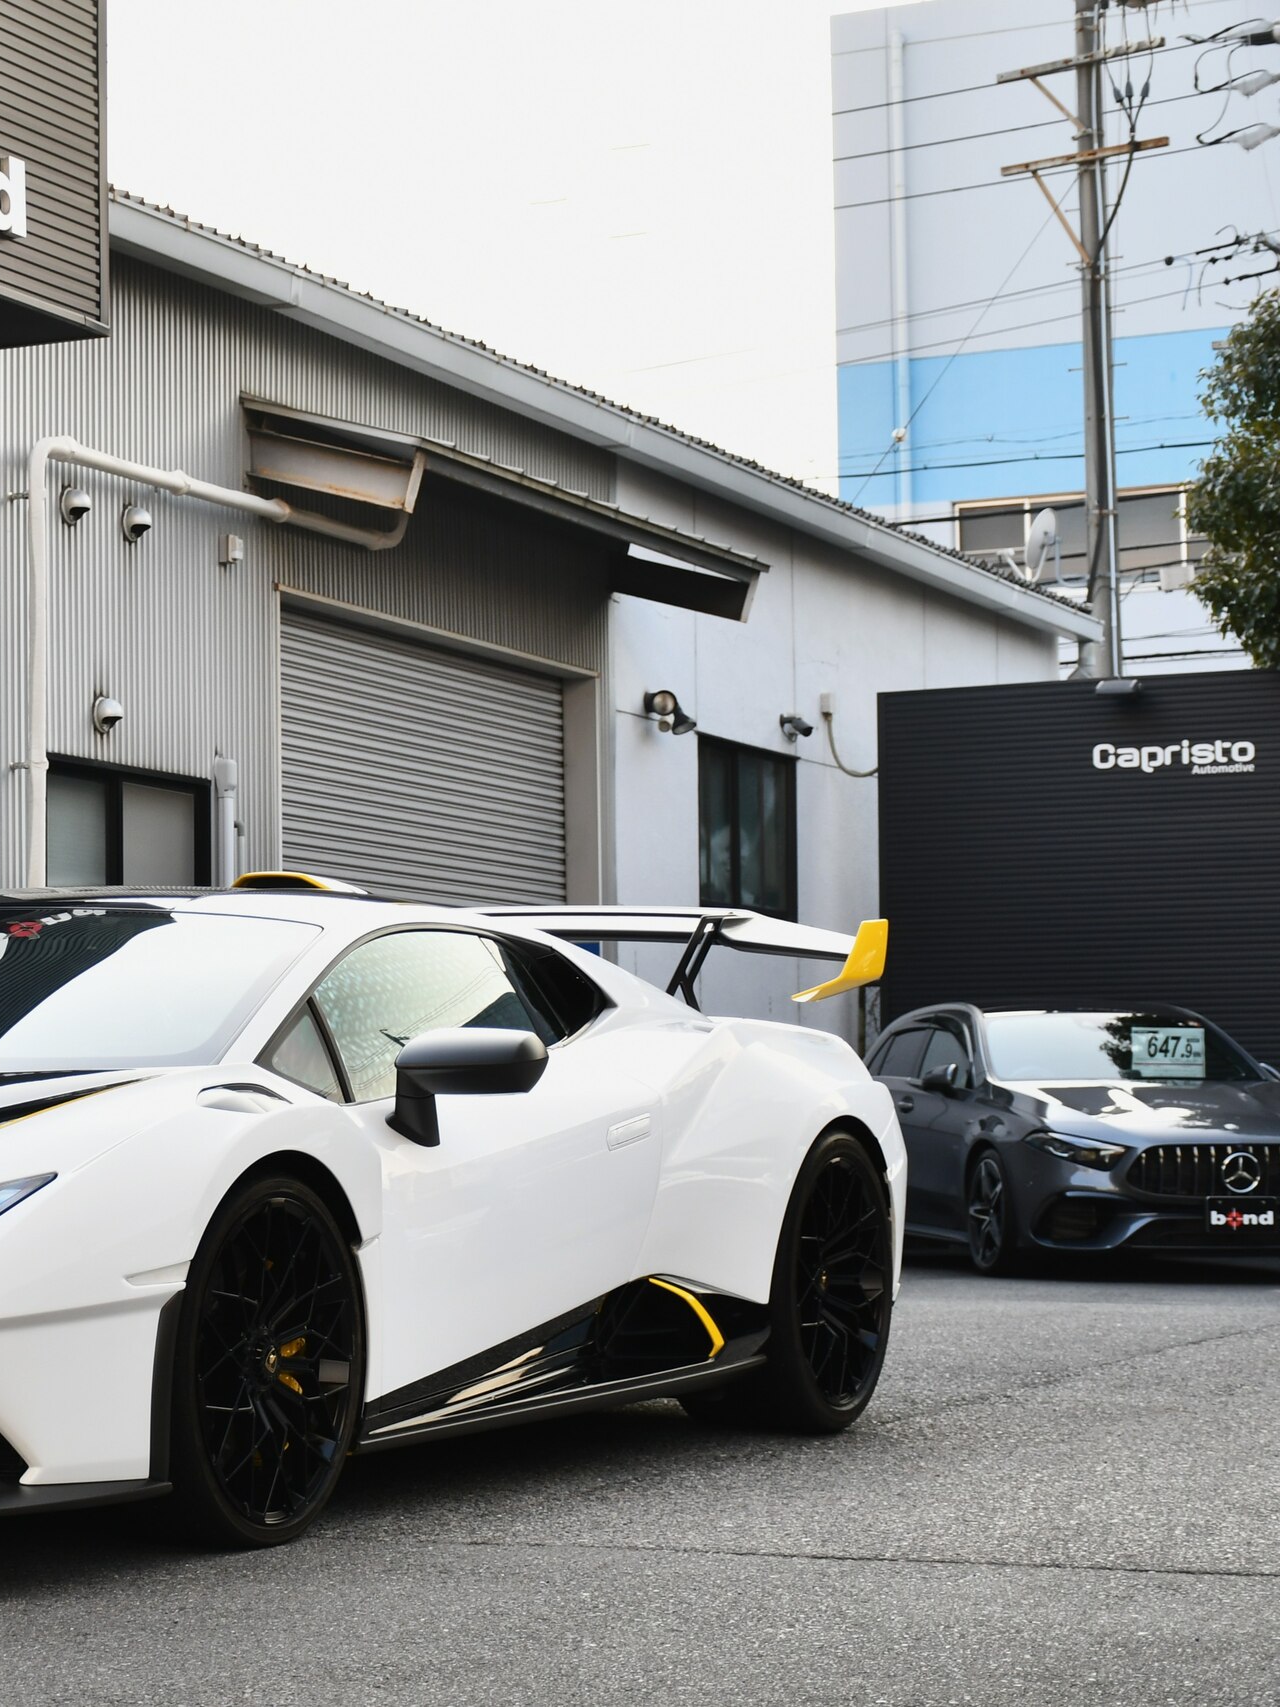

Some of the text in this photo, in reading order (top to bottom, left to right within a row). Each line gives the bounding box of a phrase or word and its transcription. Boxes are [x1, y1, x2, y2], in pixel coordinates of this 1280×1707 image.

[1092, 739, 1255, 773] Capristo
[1191, 763, 1255, 775] Automotive
[1147, 1035, 1193, 1058] 647.9
[1210, 1209, 1274, 1227] bond
